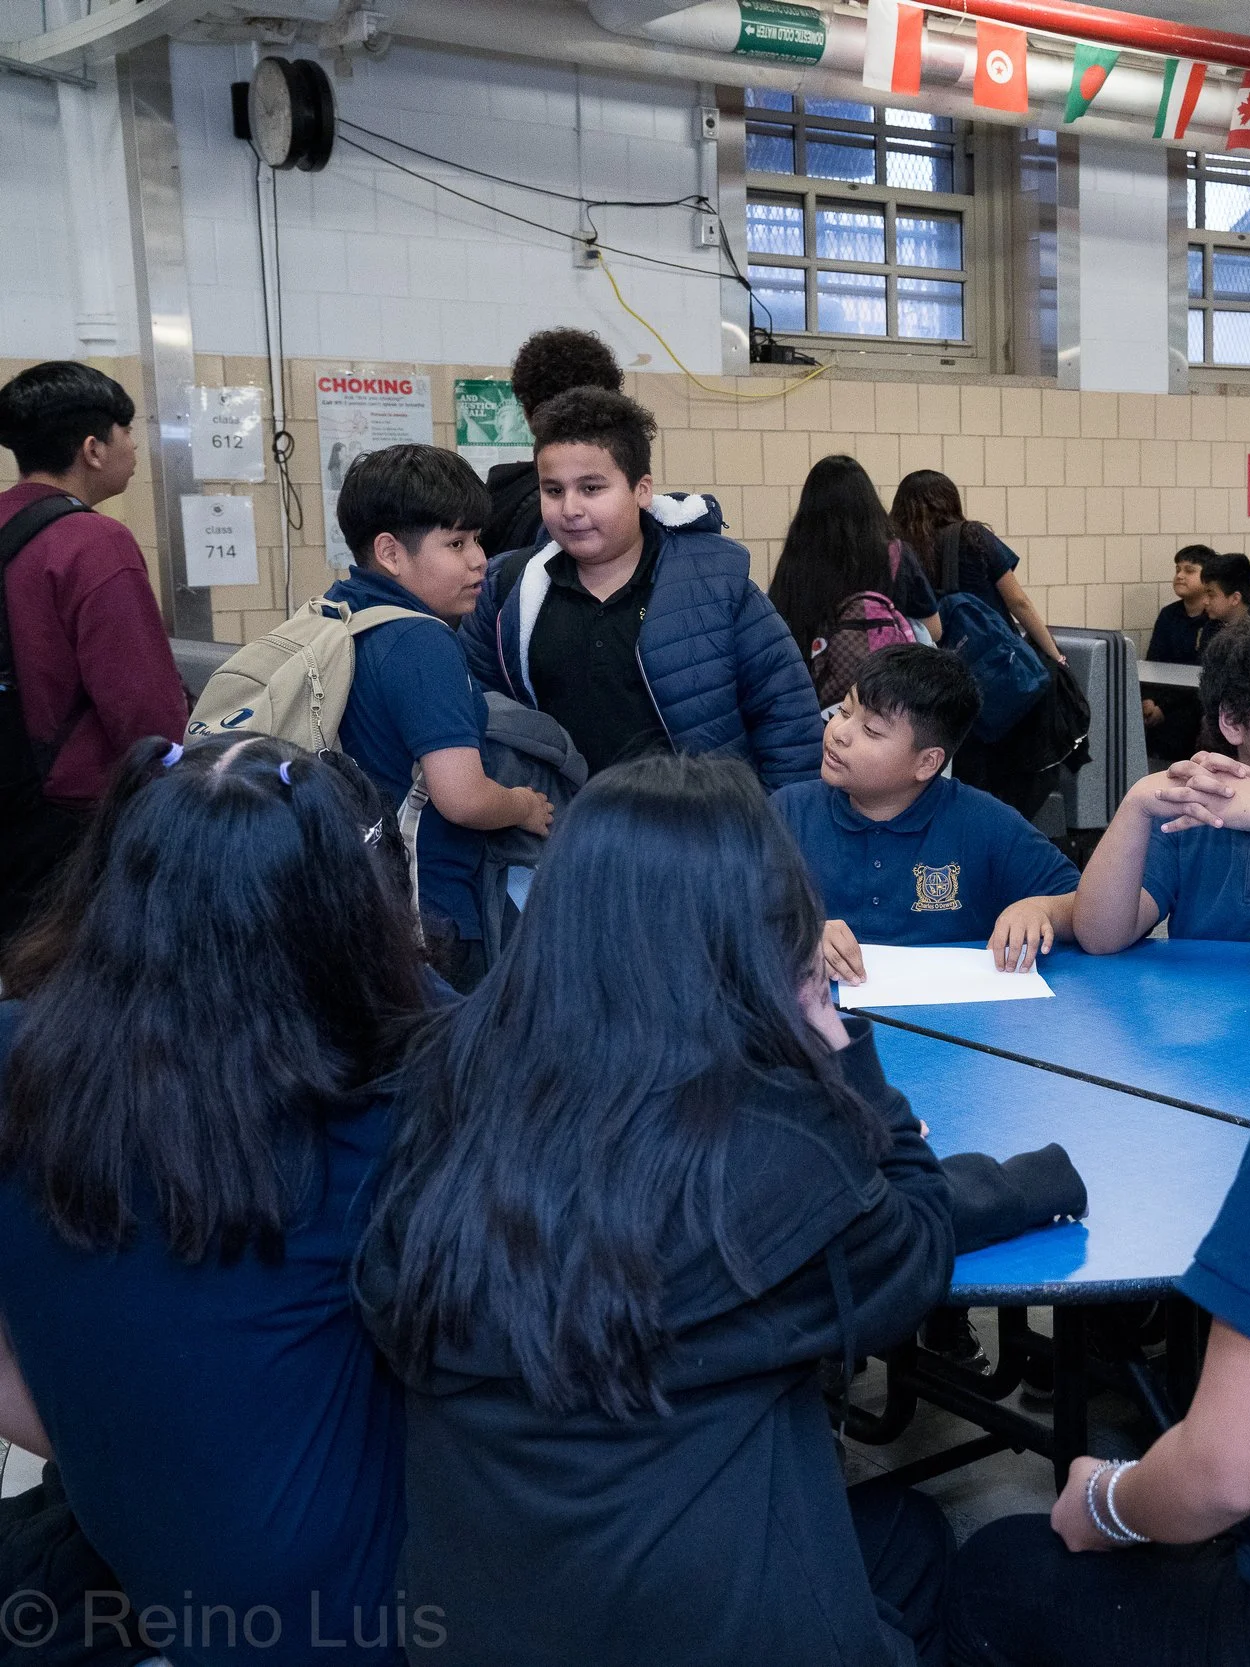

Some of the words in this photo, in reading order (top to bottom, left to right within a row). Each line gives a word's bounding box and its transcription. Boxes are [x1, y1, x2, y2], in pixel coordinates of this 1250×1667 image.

[756, 25, 778, 39] WATER
[778, 28, 795, 41] COLD
[795, 29, 824, 45] DOMESTIC
[318, 377, 413, 395] CHOKING
[460, 394, 478, 402] AND
[212, 415, 240, 424] class
[212, 434, 244, 449] 612
[205, 526, 233, 535] class
[205, 545, 237, 559] 714
